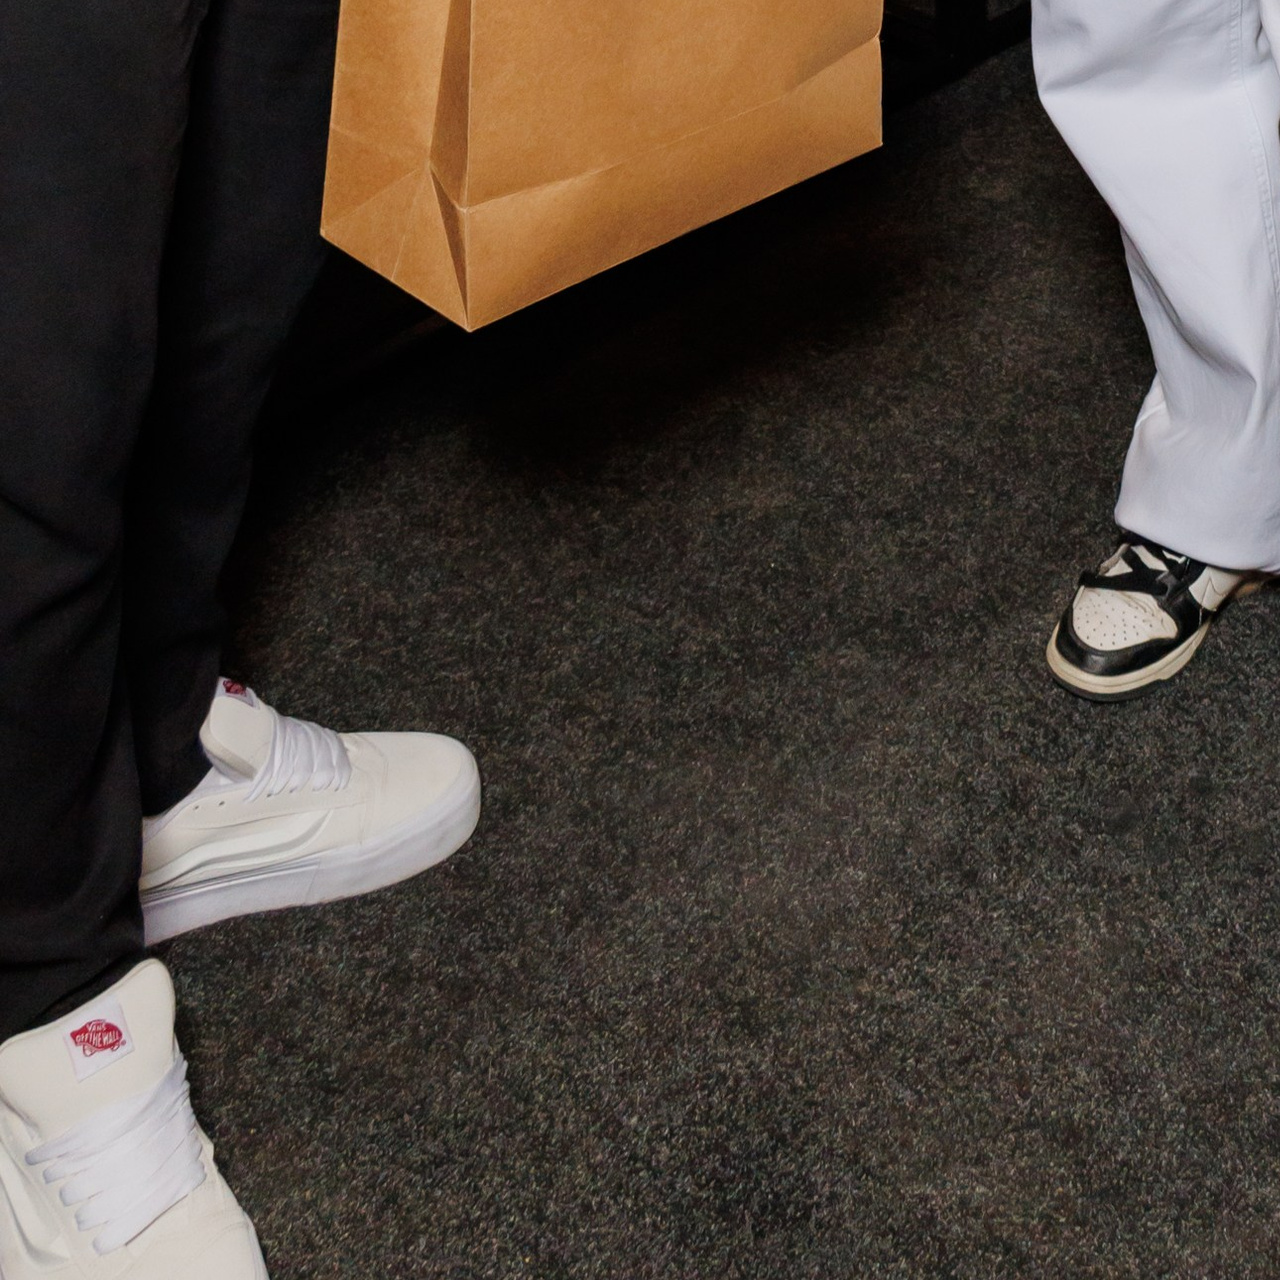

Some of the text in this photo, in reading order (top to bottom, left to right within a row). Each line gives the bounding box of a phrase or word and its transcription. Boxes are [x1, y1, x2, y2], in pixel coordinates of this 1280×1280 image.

[75, 1030, 119, 1047] OFF THE WALL
